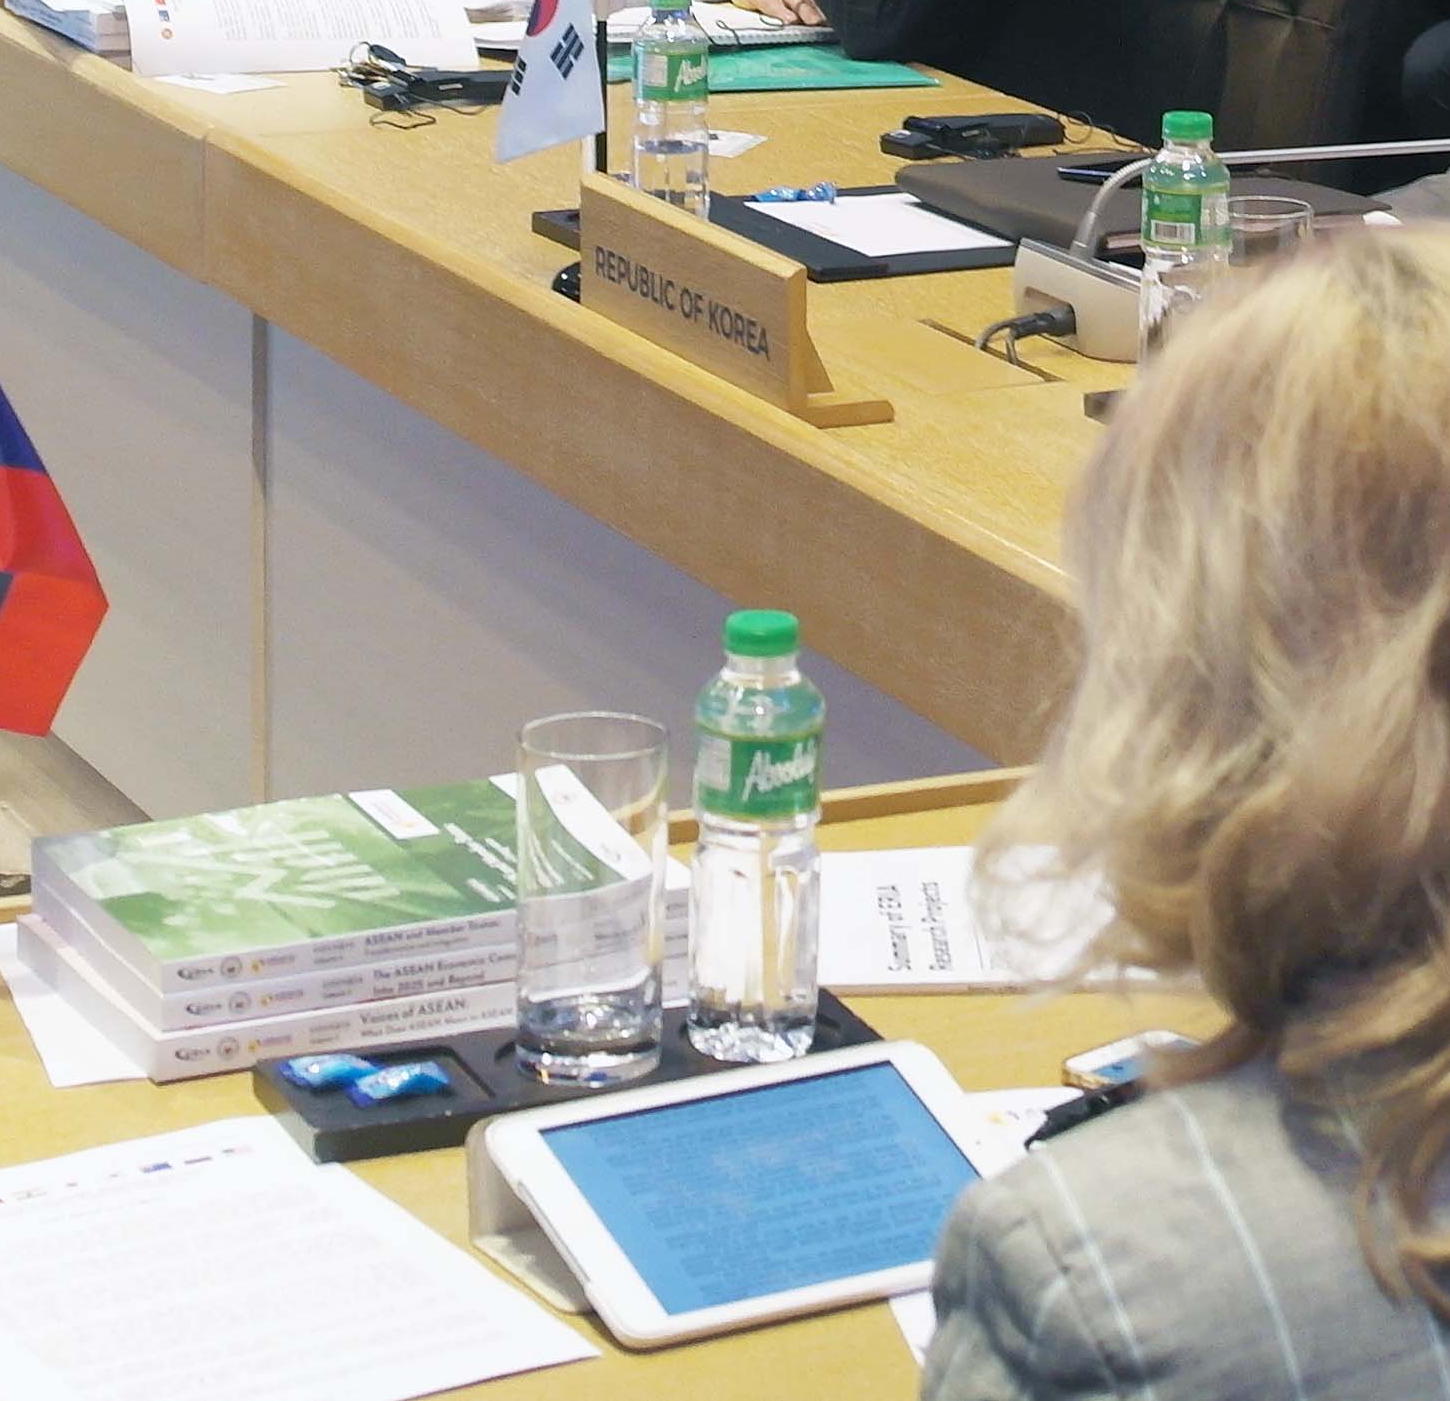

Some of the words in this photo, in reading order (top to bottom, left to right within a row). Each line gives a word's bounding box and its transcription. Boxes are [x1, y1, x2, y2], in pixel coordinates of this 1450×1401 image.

[595, 246, 675, 311] REPUBLIC
[679, 288, 704, 322] OF
[708, 300, 770, 362] KOREA
[887, 924, 912, 971] Summary
